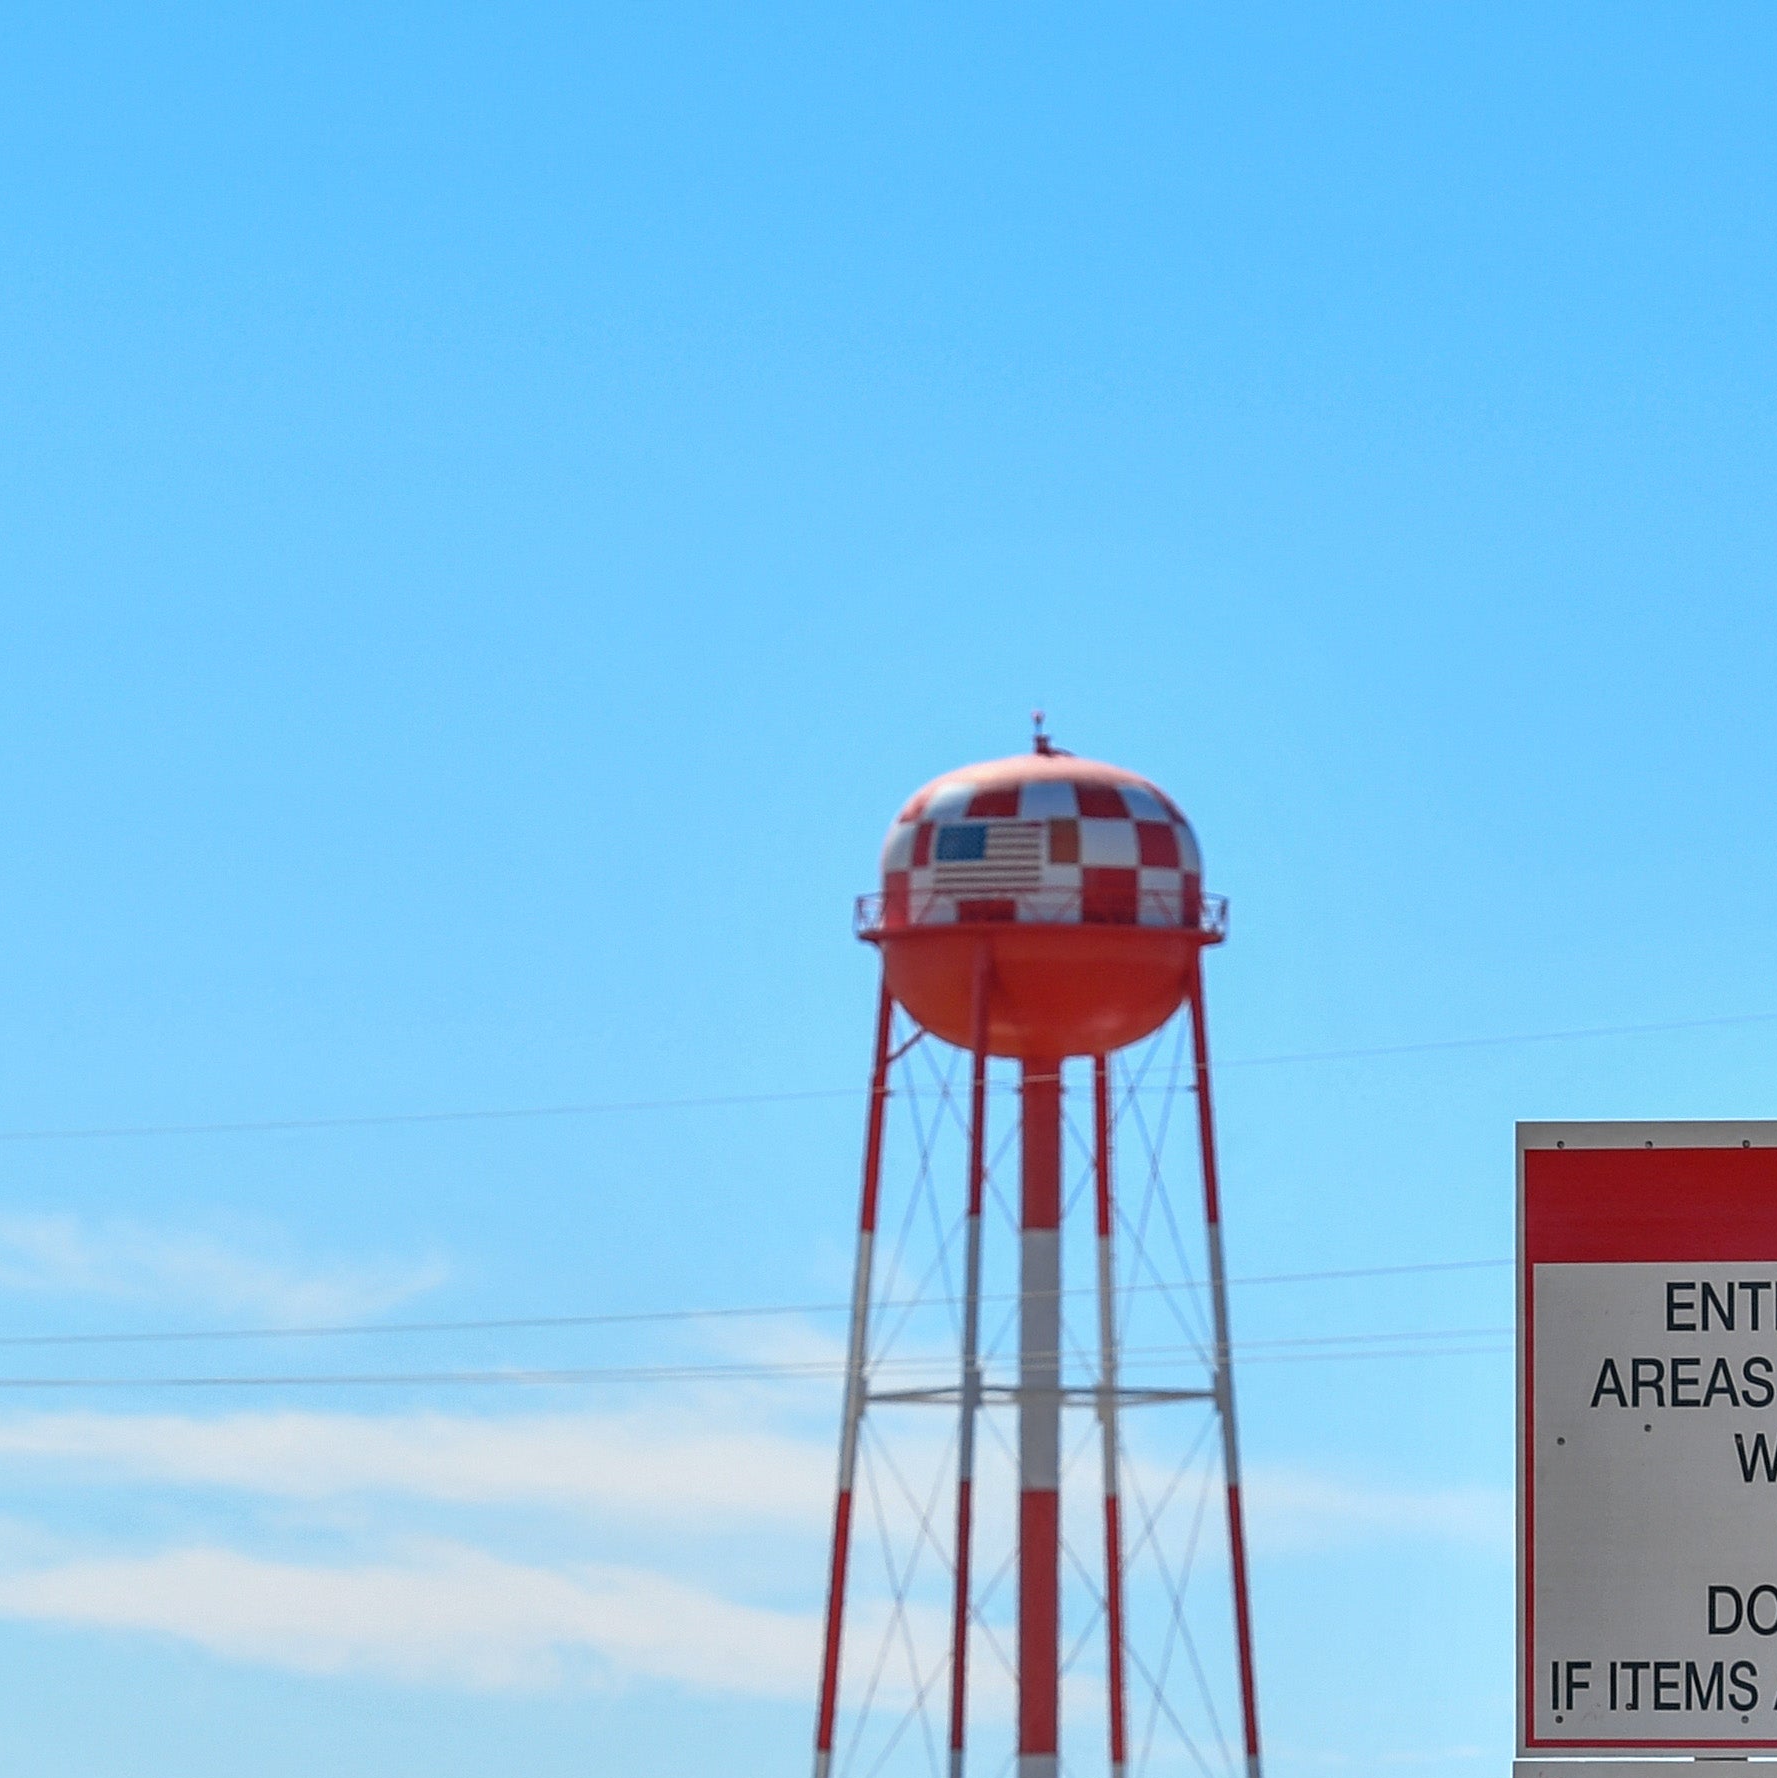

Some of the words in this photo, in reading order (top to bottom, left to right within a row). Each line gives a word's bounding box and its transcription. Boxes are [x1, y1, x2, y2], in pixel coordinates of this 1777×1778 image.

[1590, 1356, 1775, 1408] AREAS
[1551, 1660, 1592, 1713] IF
[1609, 1660, 1759, 1713] ITEMS
